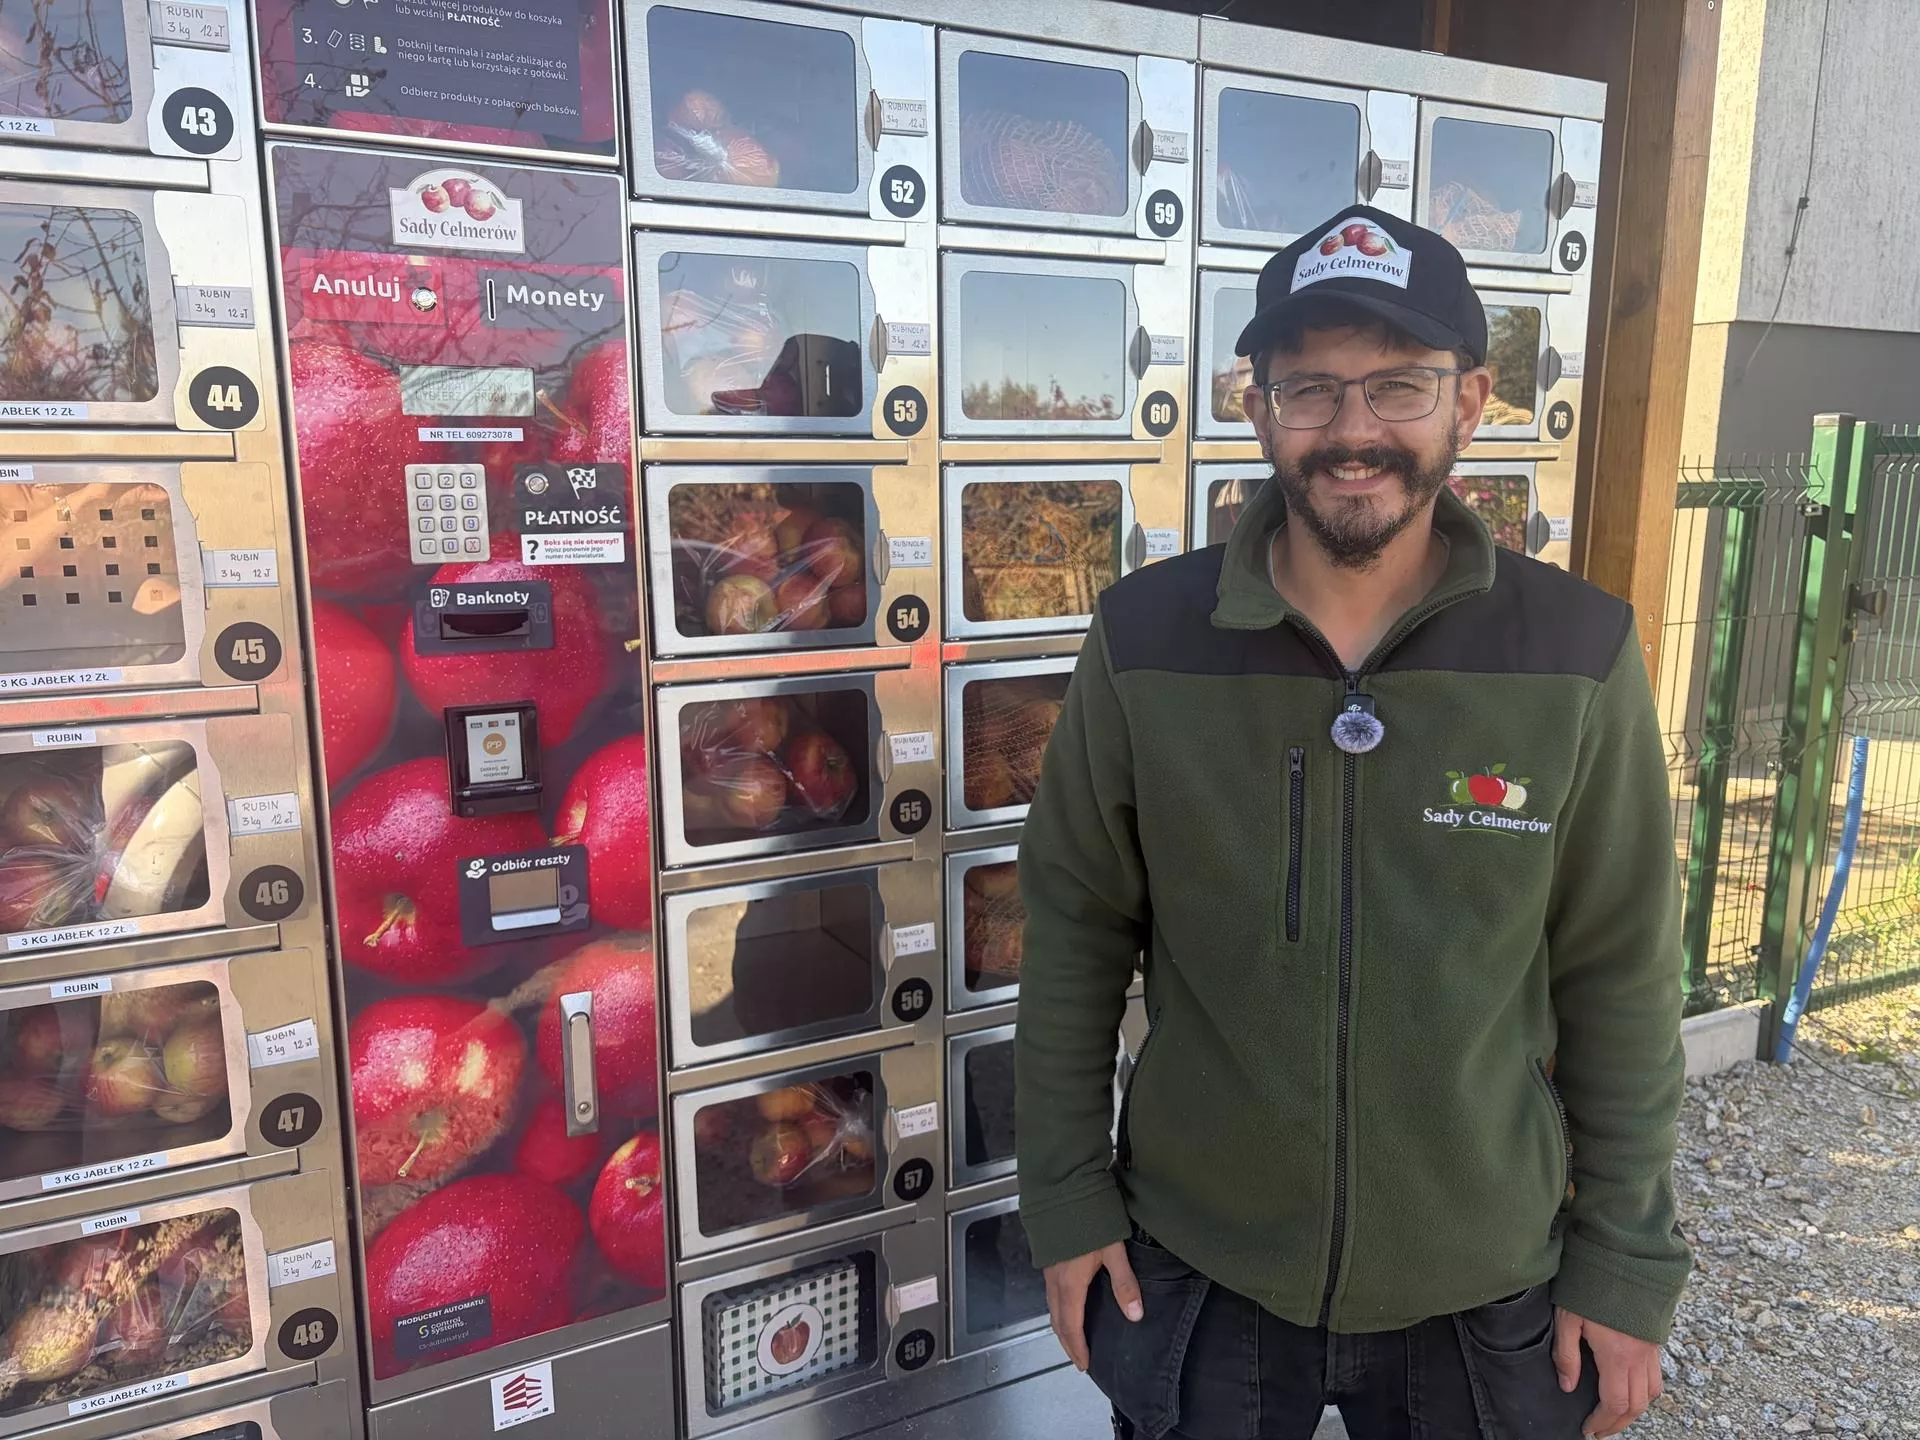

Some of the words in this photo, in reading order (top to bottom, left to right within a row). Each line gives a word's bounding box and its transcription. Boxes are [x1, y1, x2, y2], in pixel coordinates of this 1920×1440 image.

[166, 6, 203, 19] RUBIN
[396, 4, 410, 14] lub
[412, 9, 444, 21] wciśnij
[447, 12, 503, 27] PŁATNOŚĆ.
[462, 3, 513, 17] produktów
[514, 10, 526, 19] do
[528, 11, 562, 25] koszyka
[167, 21, 176, 32] 3
[179, 22, 190, 39] kg
[200, 24, 212, 37] 12
[302, 27, 318, 44] 3.
[397, 38, 432, 53] Dotknij
[434, 43, 479, 57] terminala
[486, 50, 514, 62] zapłać
[516, 55, 553, 68] zbliżając
[555, 60, 567, 69] do
[398, 51, 425, 63] niego
[427, 54, 452, 66] kartę
[454, 57, 469, 67] lub
[471, 59, 521, 75] korzystając
[530, 68, 568, 81] gotówki.
[304, 73, 322, 89] 4.
[400, 86, 438, 99] Odbierz
[440, 91, 482, 105] produkty
[491, 98, 542, 112] opłaconych
[543, 103, 579, 116] boksów.
[887, 101, 922, 113] RUBINOLA
[9, 121, 22, 130] 12
[25, 122, 40, 132] ZŁ
[180, 106, 216, 137] 43
[891, 115, 899, 128] kg
[908, 119, 918, 128] 12
[891, 179, 914, 204] 52
[1154, 202, 1176, 225] 59
[399, 218, 437, 239] Sady
[440, 221, 517, 241] Celmerów
[1566, 242, 1580, 261] 75
[1298, 261, 1328, 282] Sady
[1330, 256, 1404, 277] Celmerów
[200, 289, 231, 299] RUBIN
[312, 273, 400, 303] Anuluj
[507, 285, 605, 311] Monety
[195, 303, 202, 312] 3
[204, 303, 216, 318] kg
[228, 308, 238, 318] 12
[891, 325, 924, 334] RUBINOLA
[911, 339, 920, 349] 12
[207, 384, 243, 412] 44
[0, 407, 41, 416] ABŁEK
[45, 407, 58, 416] 12
[61, 407, 75, 416] ZŁ
[893, 400, 917, 422] 53
[1150, 403, 1171, 424] 60
[1554, 411, 1567, 429] 76
[430, 431, 445, 439] NR
[447, 431, 464, 439] TEL
[466, 431, 513, 439] 609273078
[0, 468, 19, 478] BIN
[421, 476, 427, 486] 1
[442, 476, 451, 486] 2
[465, 476, 473, 486] 3
[421, 498, 429, 508] 4
[444, 498, 452, 507] 5
[466, 497, 474, 507] 6
[423, 520, 431, 529] 7
[446, 519, 453, 529] 8
[467, 519, 475, 529] 9
[525, 506, 621, 525] PŁATNOŚĆ
[447, 542, 454, 551] 0
[230, 552, 259, 561] RUBIN
[220, 569, 228, 578] 3
[230, 569, 241, 581] kg
[252, 569, 262, 578] 12
[456, 590, 530, 606] Banknoty
[896, 608, 920, 629] 54
[231, 638, 266, 665] 45
[1, 680, 8, 688] 3
[11, 678, 28, 687] KG
[31, 675, 76, 686] JABŁEK
[80, 674, 92, 682] 12
[95, 673, 109, 681] ZŁ
[47, 733, 83, 743] RUBIN
[242, 800, 279, 812] RUBIN
[899, 800, 922, 822] 55
[242, 817, 249, 826] 3
[250, 815, 261, 830] kg
[271, 813, 283, 825] 12
[1423, 808, 1464, 827] Sady
[1468, 810, 1552, 834] Celmerów
[492, 858, 532, 872] Odbiór
[535, 854, 571, 867] reszty
[255, 880, 289, 906] 46
[22, 938, 28, 946] 3
[31, 935, 48, 945] KG
[51, 930, 94, 942] JABŁEK
[99, 928, 110, 936] 12
[113, 925, 128, 934] ZŁ
[64, 982, 99, 994] RUBIN
[901, 990, 924, 1011] 56
[265, 1028, 296, 1042] RUBIN
[267, 1046, 273, 1056] 3
[274, 1044, 285, 1055] kg
[293, 1039, 304, 1049] 12
[277, 1107, 305, 1133] 47
[55, 1176, 61, 1184] 3
[64, 1173, 80, 1183] KG
[83, 1164, 125, 1179] JABŁEK
[128, 1161, 140, 1170] 12
[142, 1158, 156, 1167] ZŁ
[904, 1168, 923, 1191] 57
[94, 1215, 127, 1229] RUBIN
[283, 1251, 313, 1266] RUBIN
[283, 1268, 289, 1277] 3
[291, 1267, 300, 1277] kg
[311, 1259, 322, 1270] 12
[397, 1310, 442, 1327] PRODUCENT
[431, 1316, 461, 1329] control
[292, 1320, 324, 1346] 48
[904, 1338, 926, 1361] 58
[81, 1402, 87, 1410] 3
[90, 1397, 106, 1408] KG
[108, 1386, 148, 1403] JABŁEK
[152, 1383, 163, 1391] 12
[165, 1380, 178, 1388] ZŁ
